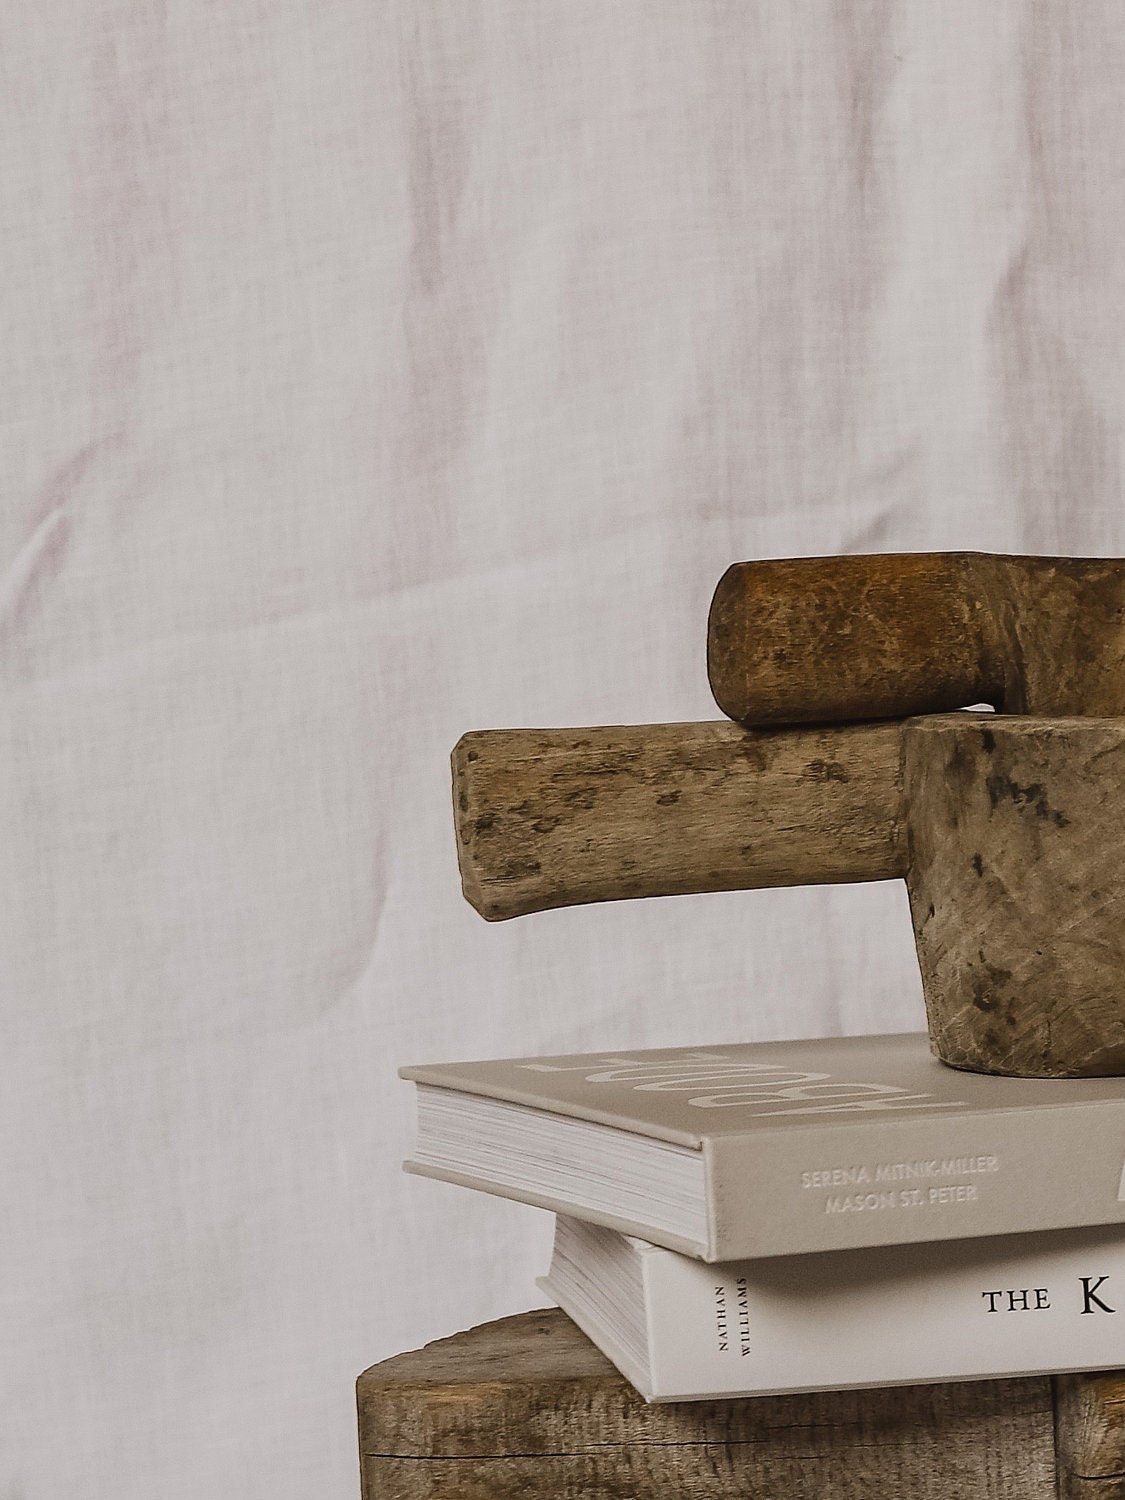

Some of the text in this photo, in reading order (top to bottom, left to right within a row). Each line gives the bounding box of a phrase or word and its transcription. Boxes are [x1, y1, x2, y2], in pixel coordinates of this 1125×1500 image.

[800, 1155, 1000, 1189] SERENA MITNIK-MILLER
[825, 1184, 979, 1214] MASON ST. PETER
[736, 1277, 751, 1357] WILLIAMS
[981, 1287, 1051, 1313] THE
[714, 1286, 729, 1352] NATHAN
